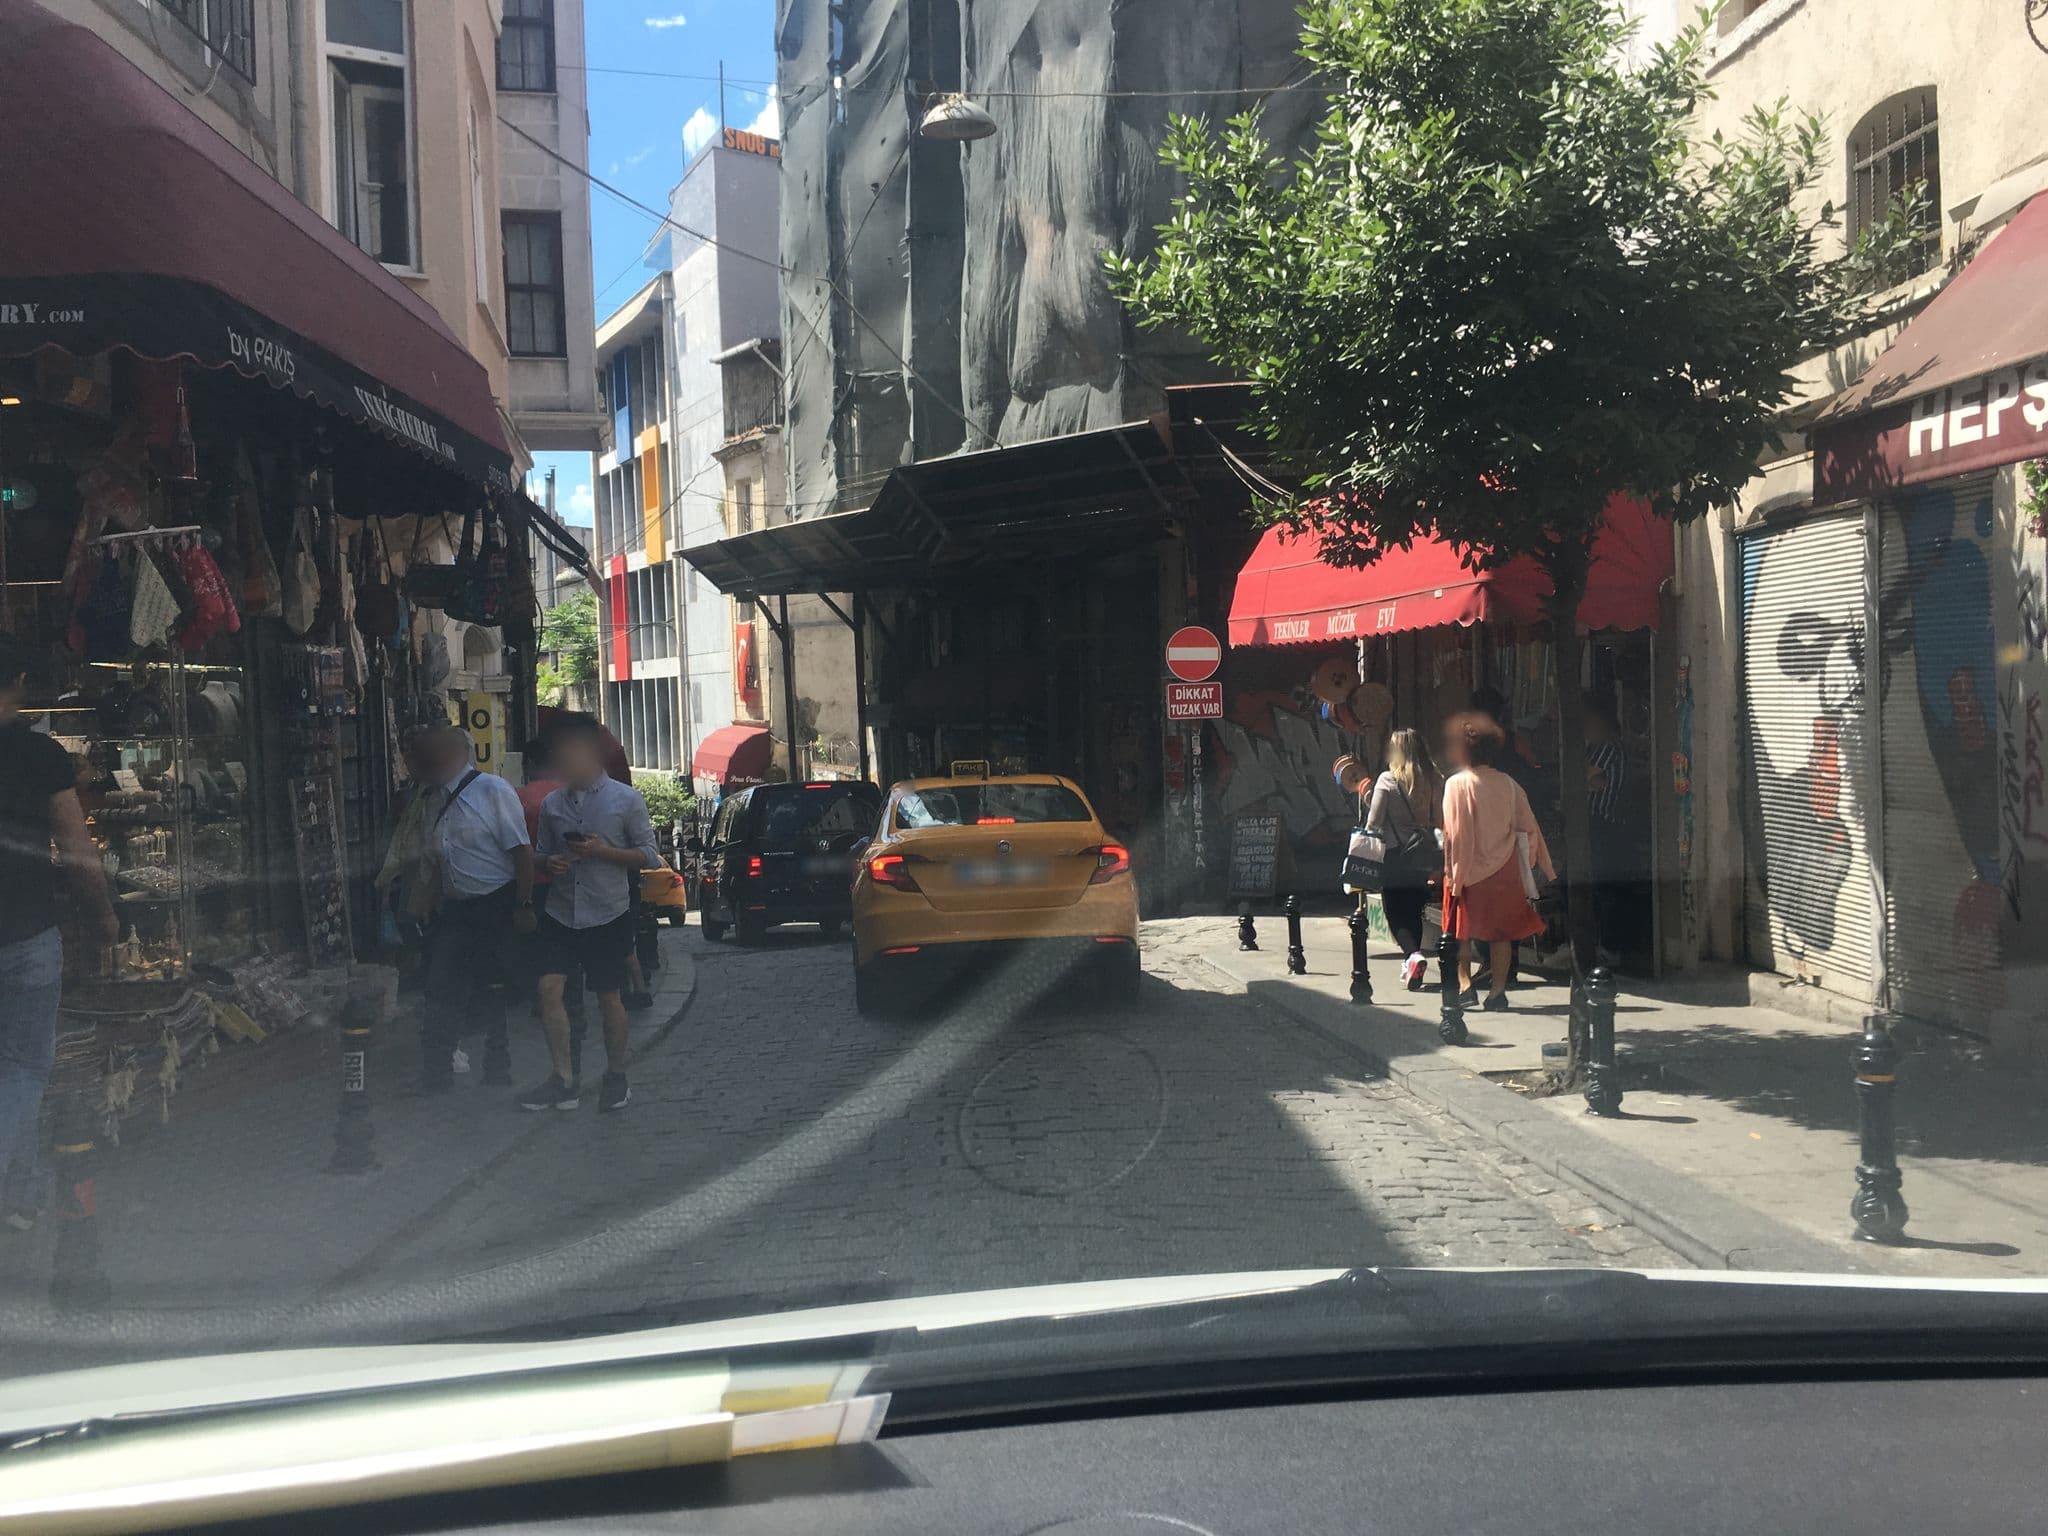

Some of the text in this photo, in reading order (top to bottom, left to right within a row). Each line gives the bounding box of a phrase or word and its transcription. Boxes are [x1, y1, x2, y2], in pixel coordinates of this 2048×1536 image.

[226, 326, 250, 364] by
[1273, 600, 1397, 640] TEKİNLER MÜZİK EVİ
[1175, 686, 1214, 700] DİKKAT
[1171, 702, 1220, 716] TUZAK VAR
